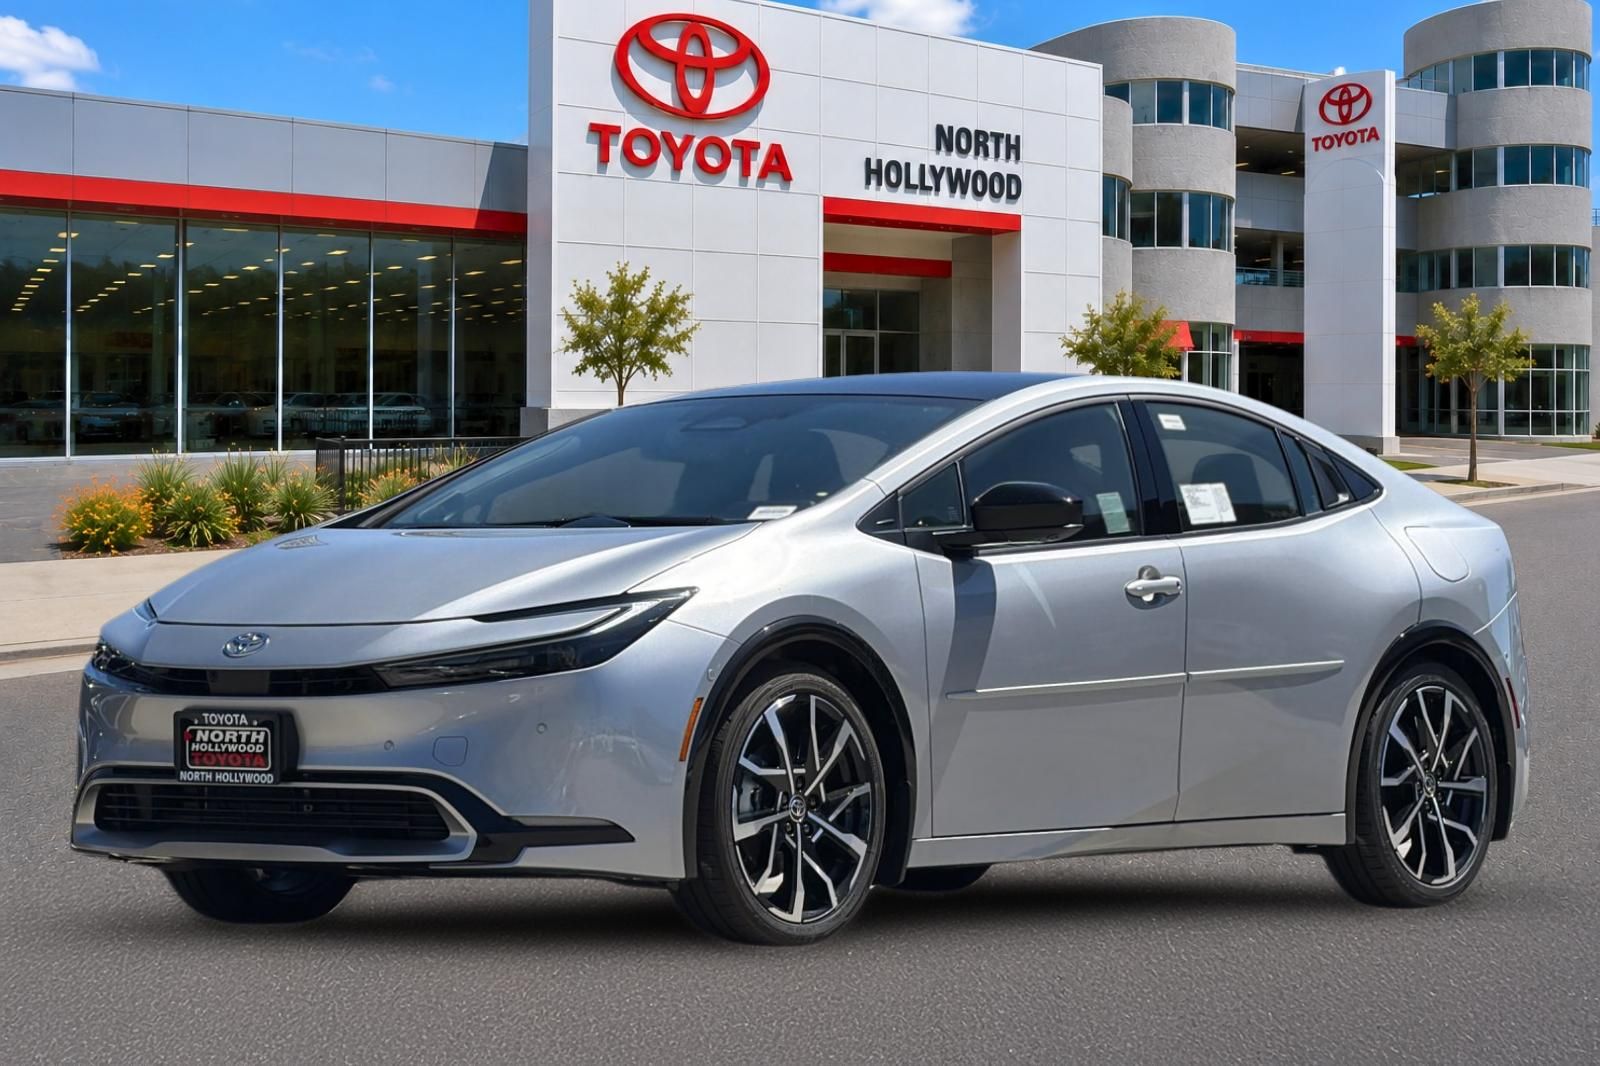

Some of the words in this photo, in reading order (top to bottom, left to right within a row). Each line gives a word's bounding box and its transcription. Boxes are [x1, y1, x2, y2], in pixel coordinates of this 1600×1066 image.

[935, 123, 1022, 162] NORTH
[1312, 126, 1380, 152] TOYOTA
[589, 122, 793, 182] TOYOTA
[864, 157, 1022, 201] HOLLYWOOD
[202, 713, 248, 725] TOYOTA
[195, 730, 265, 743] NORTH
[191, 743, 264, 753] HOLLYWOOD
[191, 753, 266, 767] TOYOTA
[180, 771, 212, 781] NORTH
[215, 773, 274, 784] HOLLYWOOD
